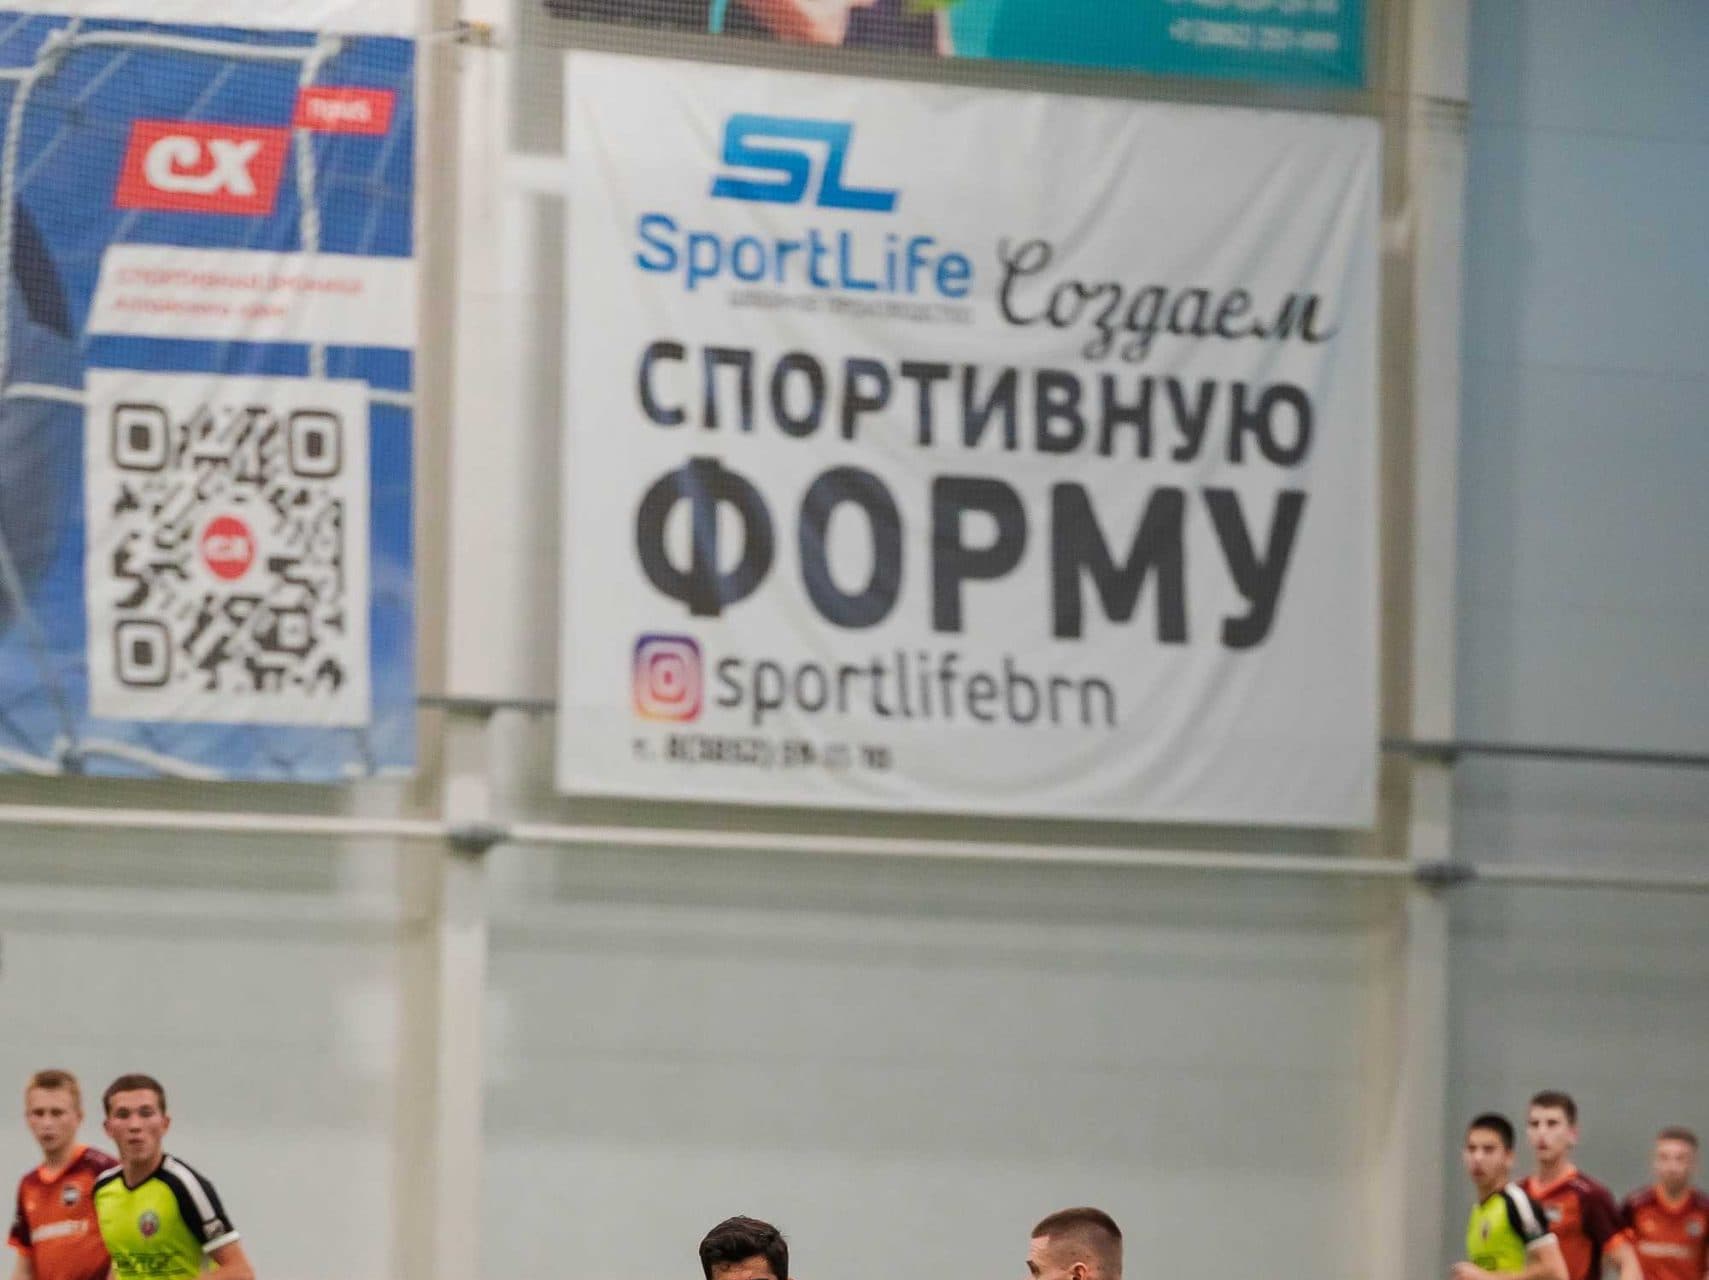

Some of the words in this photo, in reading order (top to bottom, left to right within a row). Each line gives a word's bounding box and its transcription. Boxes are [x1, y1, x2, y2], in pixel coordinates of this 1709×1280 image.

[710, 112, 900, 213] SL
[636, 213, 974, 299] SportLife
[999, 238, 1339, 363] Создаем
[638, 338, 1313, 468] СПОРТИВНУЮ
[635, 455, 1308, 650] ФОРМУ
[714, 648, 1118, 728] sportlifebrn
